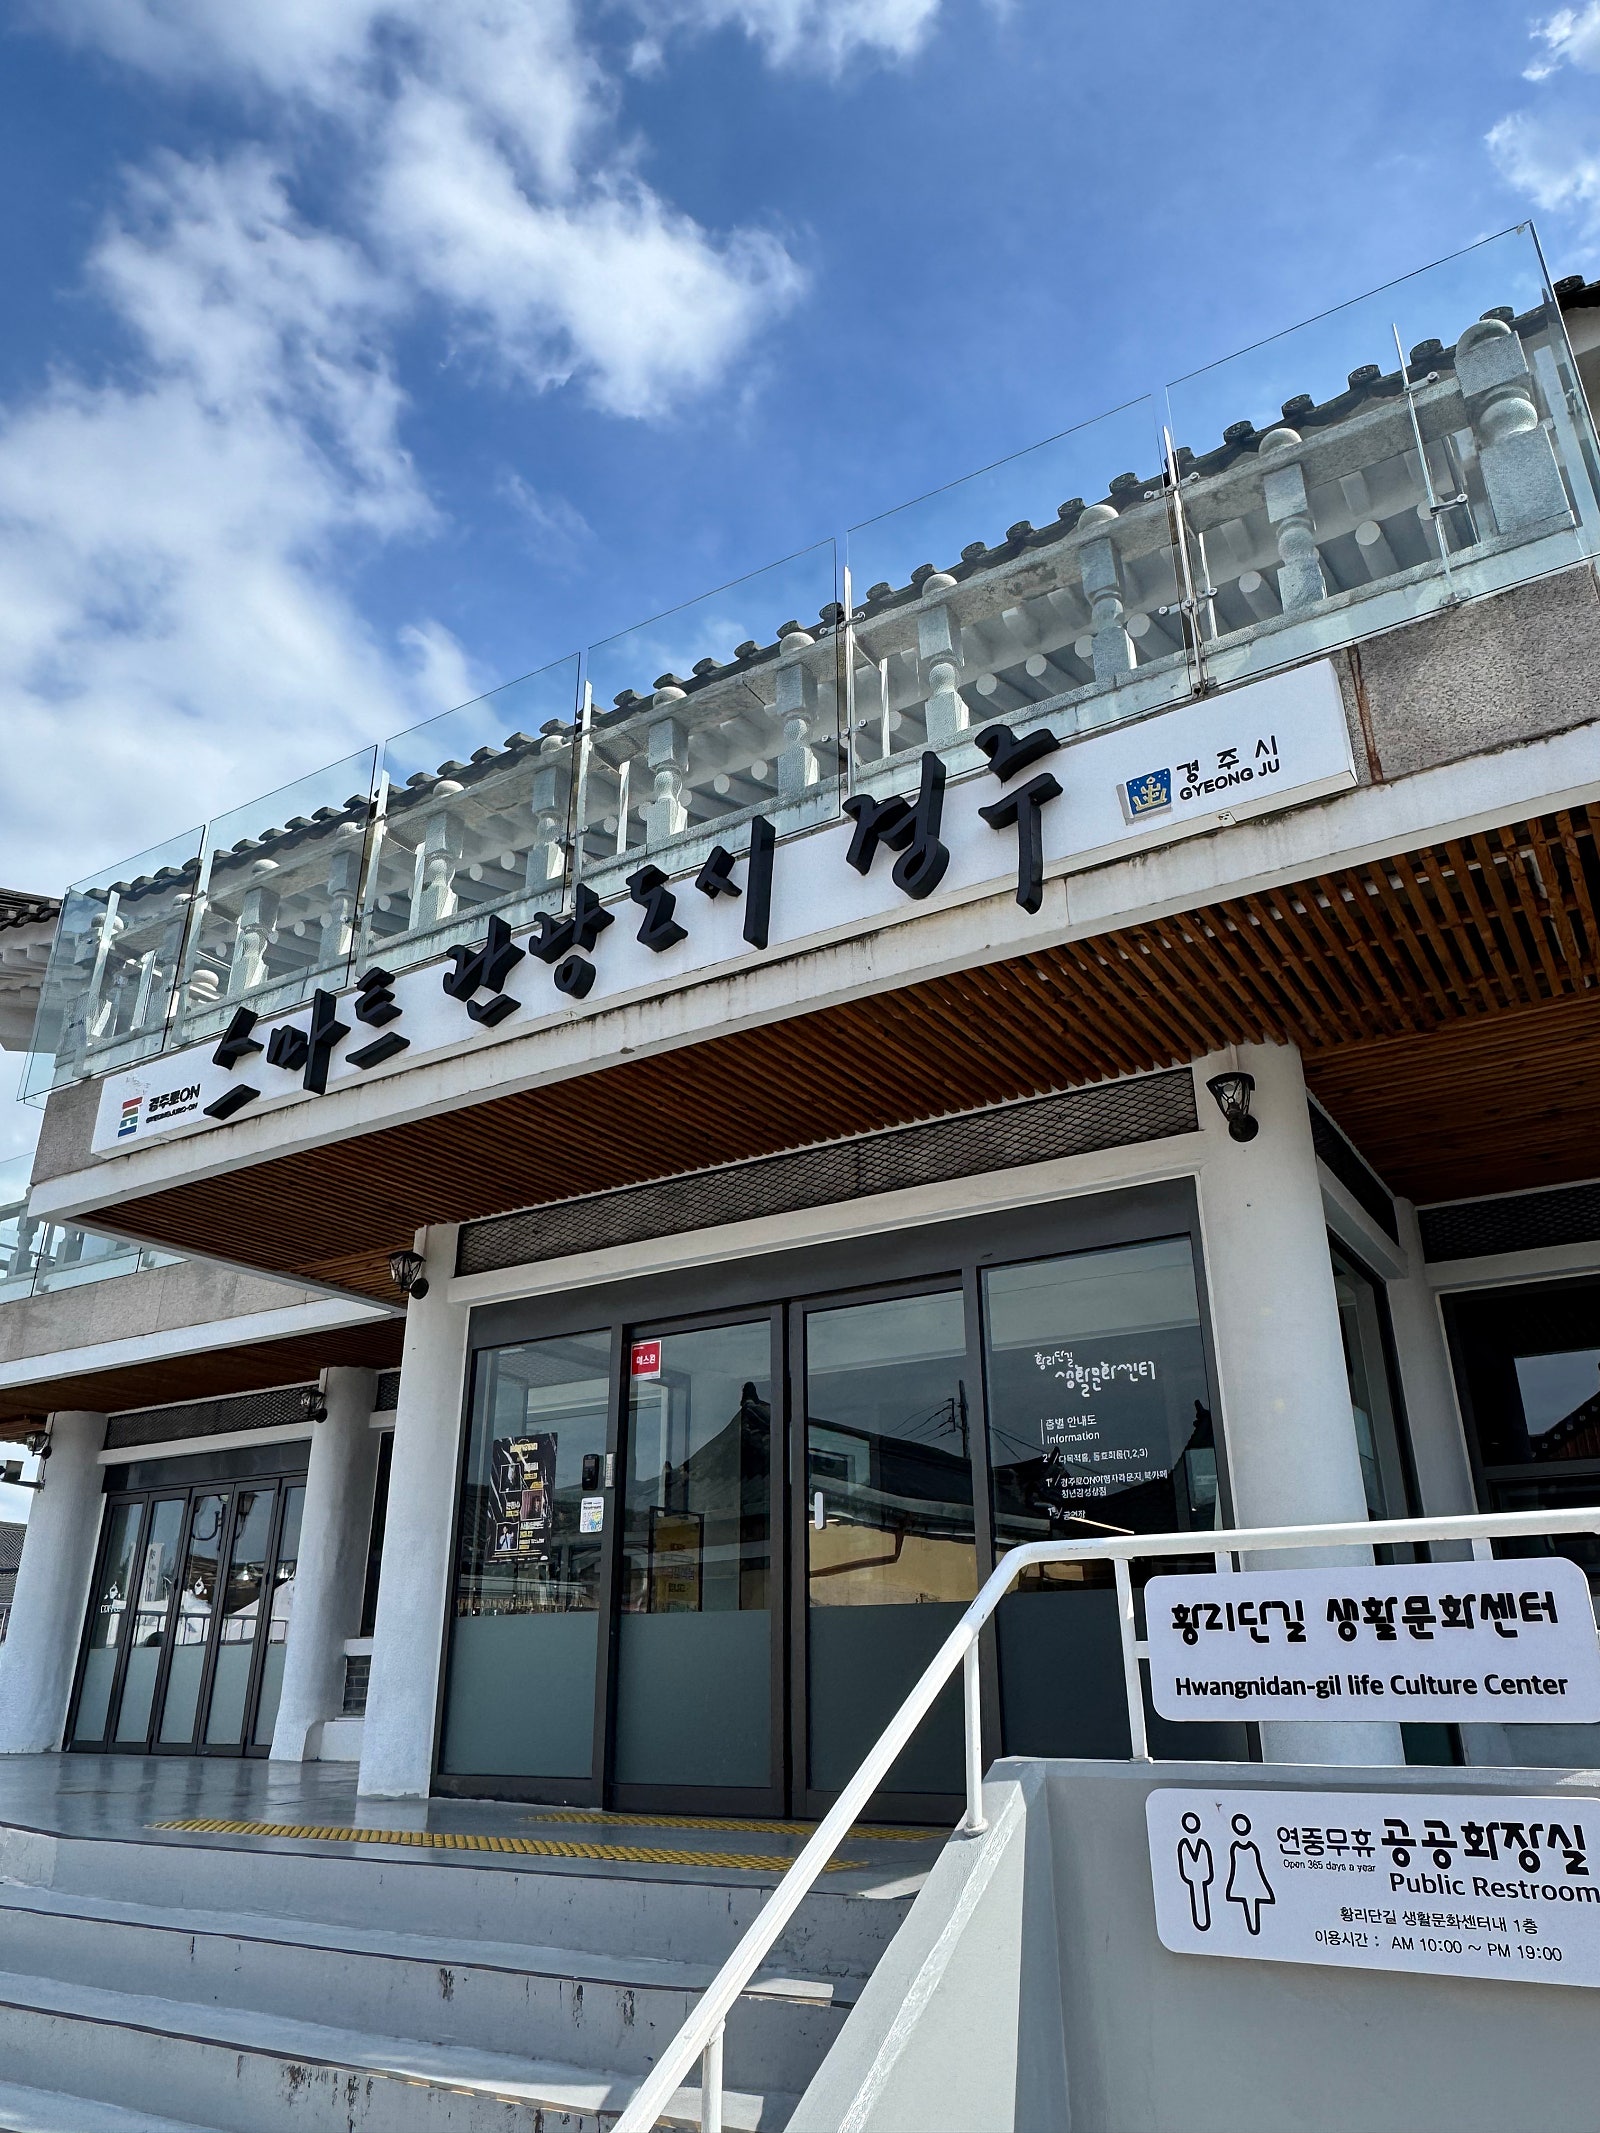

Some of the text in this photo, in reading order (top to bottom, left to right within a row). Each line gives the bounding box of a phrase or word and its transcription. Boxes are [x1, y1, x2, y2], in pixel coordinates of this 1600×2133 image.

[1176, 735, 1278, 783] 경주시
[1179, 758, 1280, 800] GYEONG JU
[203, 724, 1063, 1120] 스마트 관광도시 경주
[1034, 1350, 1073, 1370] 황리단길
[1055, 1361, 1155, 1397] 생활문화센터
[1067, 1414, 1097, 1428] 안내도
[1047, 1431, 1100, 1444] Information
[1171, 1590, 1559, 1645] 황리단길 생활문화센터
[1175, 1674, 1569, 1699] Hwangnidan-gil life Culture Center
[1277, 1818, 1590, 1875] 연중무휴 공공화장실
[1283, 1858, 1376, 1872] Open 365 days a year
[1389, 1872, 1466, 1896] Public
[1340, 1906, 1538, 1934] 황리단길 생활문화센터내 1층
[1315, 1930, 1369, 1948] 이용시간
[1391, 1936, 1414, 1951] AM
[1419, 1939, 1462, 1954] 10:00
[1487, 1943, 1511, 1958] PM
[1517, 1945, 1563, 1961] 19:00
